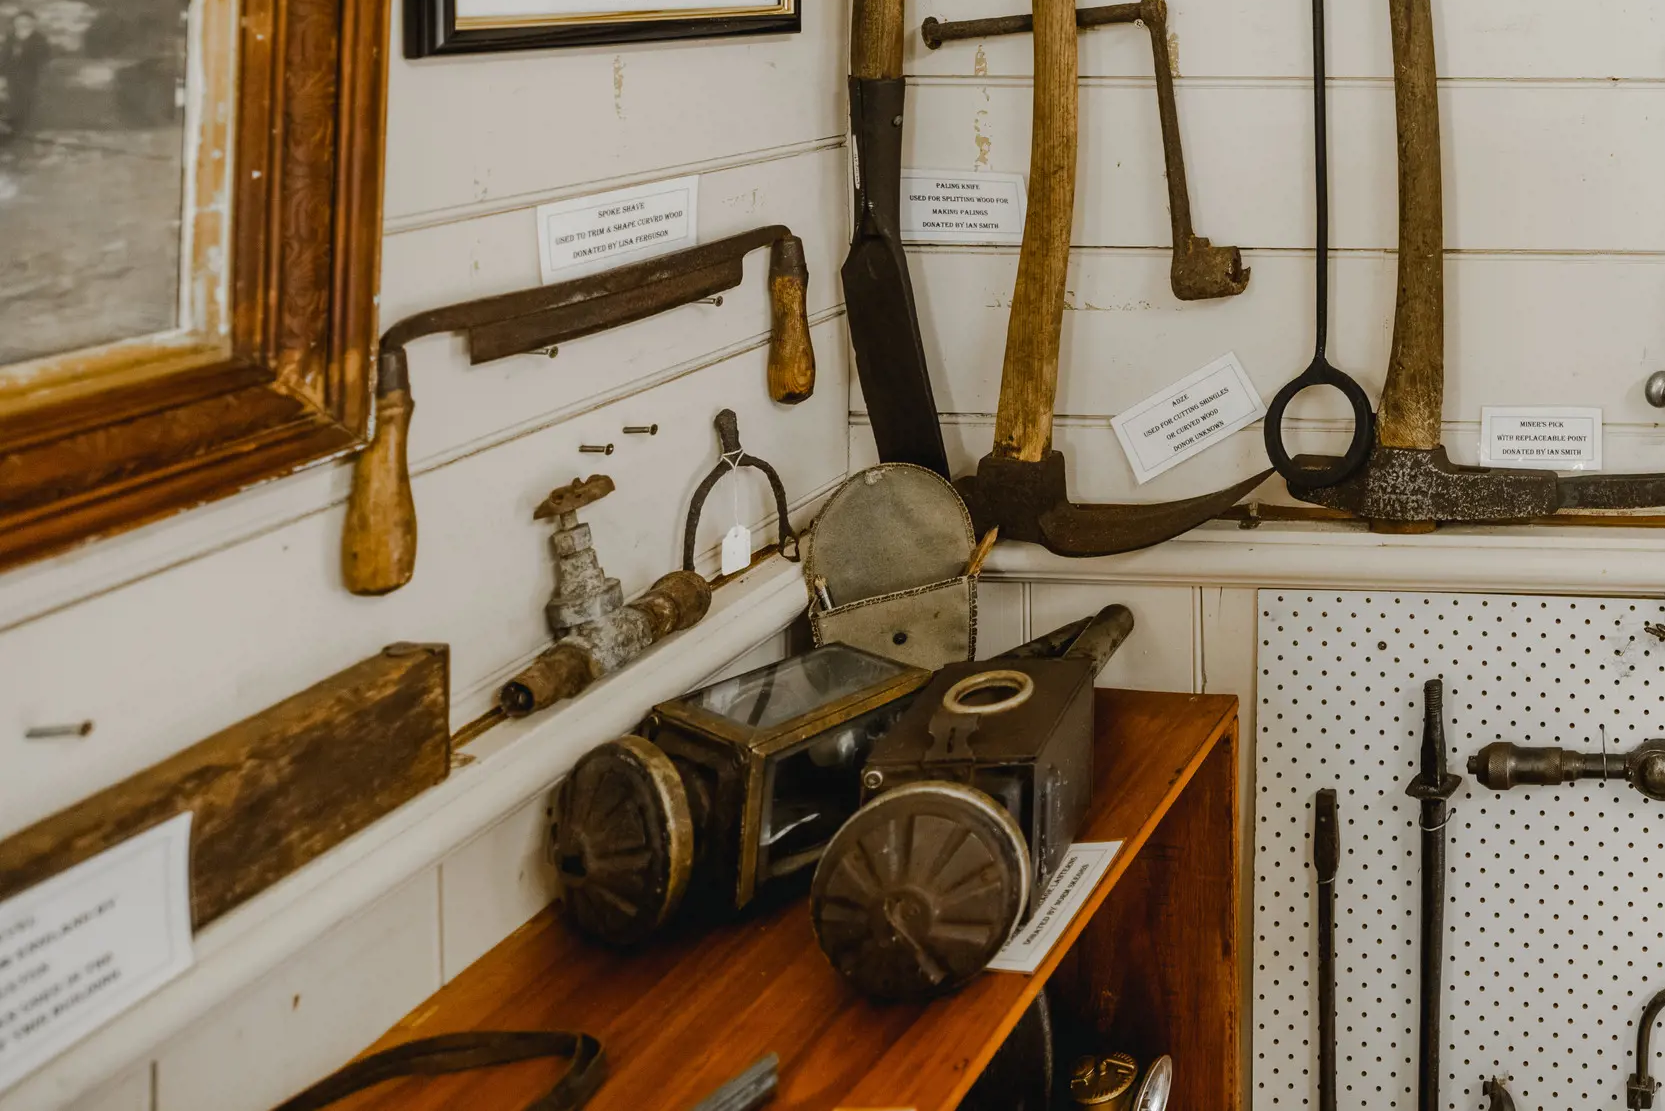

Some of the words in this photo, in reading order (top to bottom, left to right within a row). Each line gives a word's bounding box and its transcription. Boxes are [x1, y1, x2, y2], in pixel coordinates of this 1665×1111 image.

[598, 205, 621, 218] SPOKE
[622, 202, 645, 213] SHAVE
[555, 234, 575, 245] USED
[588, 228, 605, 238] TRIM
[613, 220, 636, 232] SHAPE
[664, 211, 683, 220] WOOD
[573, 244, 607, 259] DONATED
[608, 241, 618, 251] BY
[619, 238, 633, 248] LISA
[635, 230, 669, 243] FERGUSON
[1143, 426, 1160, 437] USED
[1160, 417, 1174, 429] FOR
[1174, 404, 1199, 421] CUTTING
[1199, 387, 1229, 406] SHINGLES
[1172, 394, 1189, 407] ADZE
[1166, 432, 1176, 440] OR
[1176, 419, 1201, 435] CURVED
[1201, 408, 1219, 421] WOOD
[1173, 437, 1195, 452] DONOR
[1194, 420, 1225, 440] UNKNOWN
